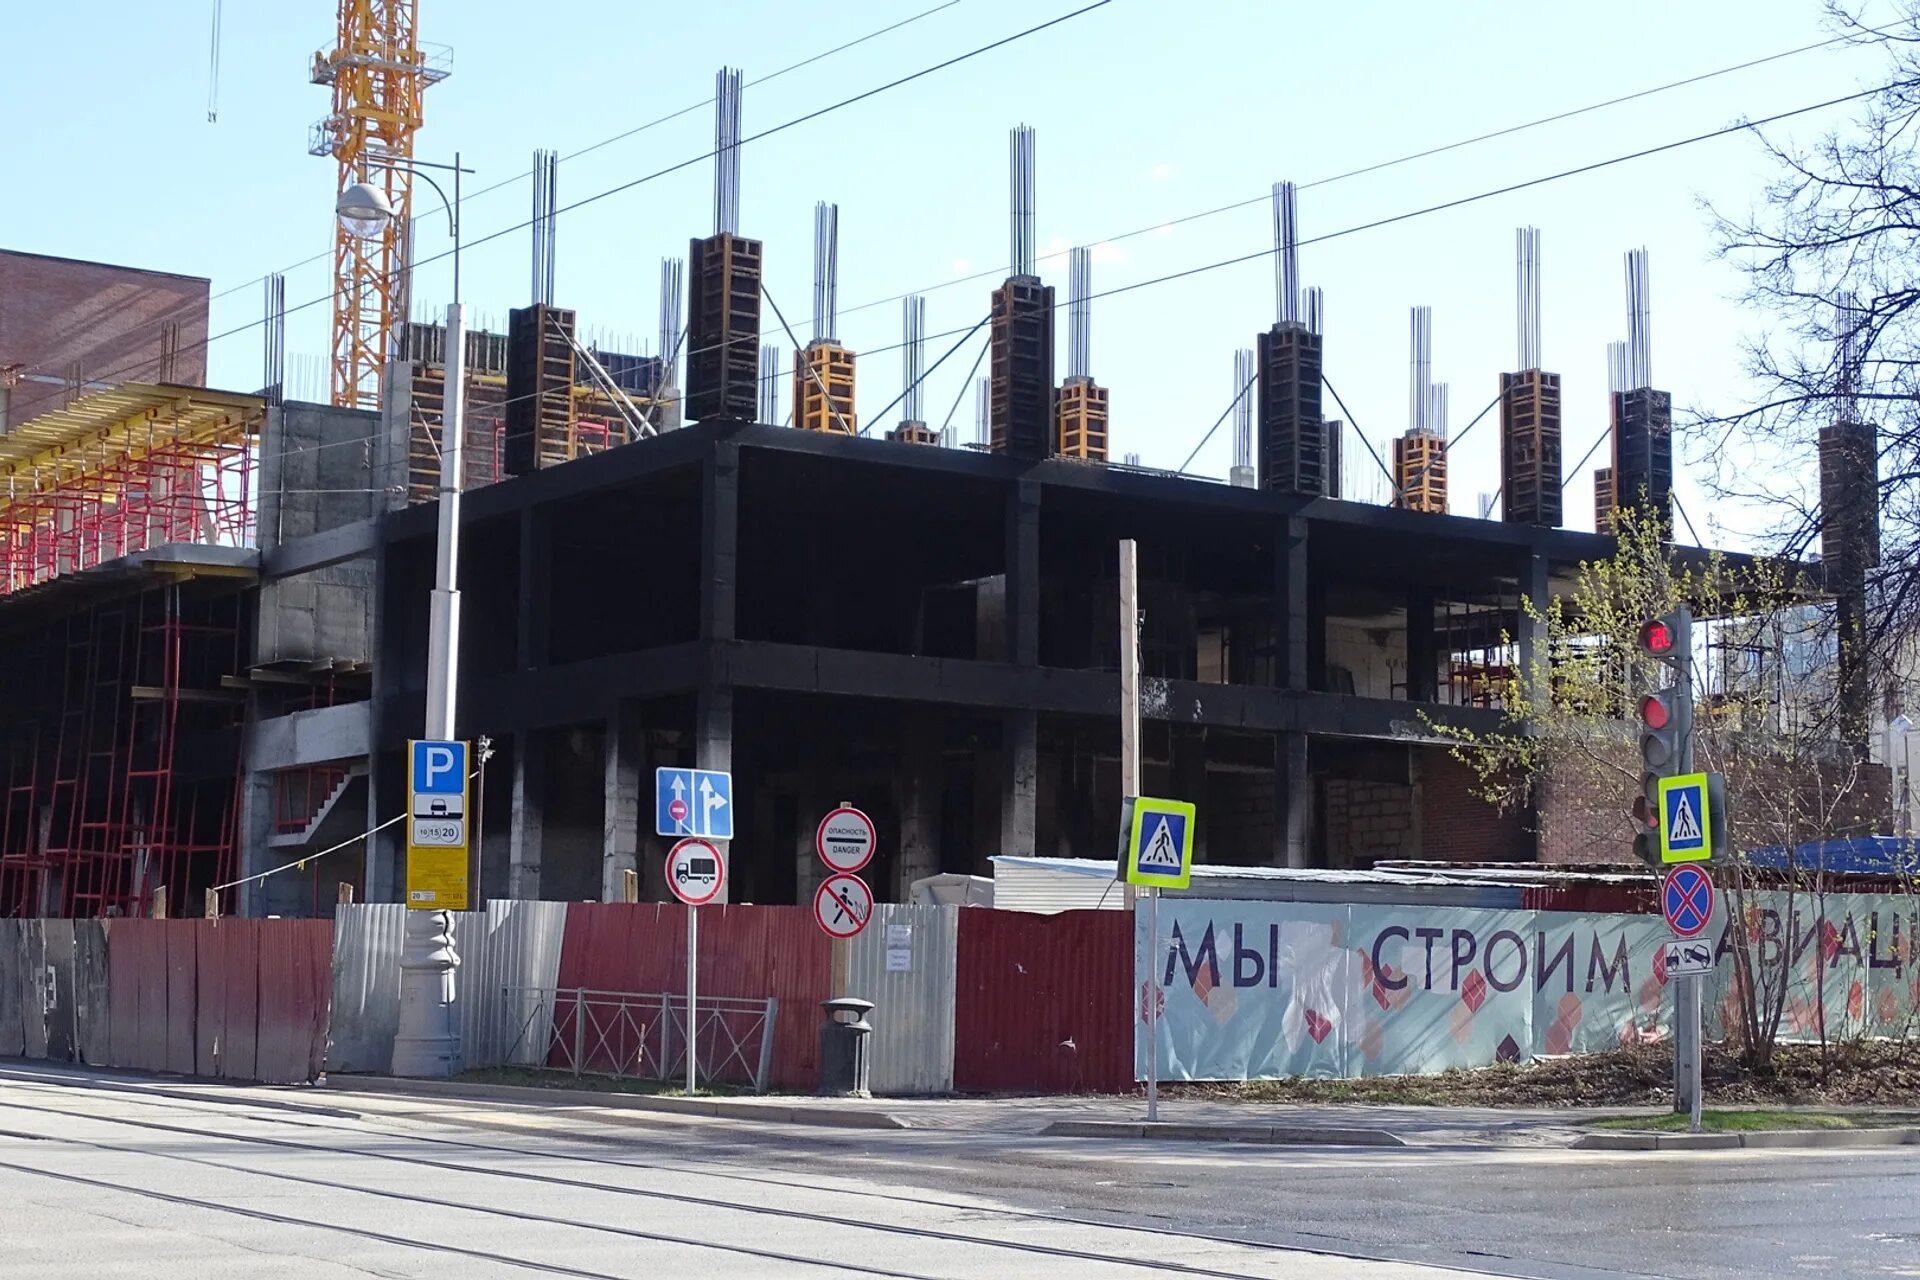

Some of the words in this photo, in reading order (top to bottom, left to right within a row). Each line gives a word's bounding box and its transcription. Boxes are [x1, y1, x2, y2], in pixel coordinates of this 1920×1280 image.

[426, 747, 454, 787] P
[430, 828, 439, 836] 15
[442, 828, 454, 837] 20
[828, 827, 867, 836] ОПАСНОСТЬ
[832, 845, 860, 854] DANGER
[1163, 918, 1279, 989] МЫ
[1371, 925, 1632, 994] СТРОИМ
